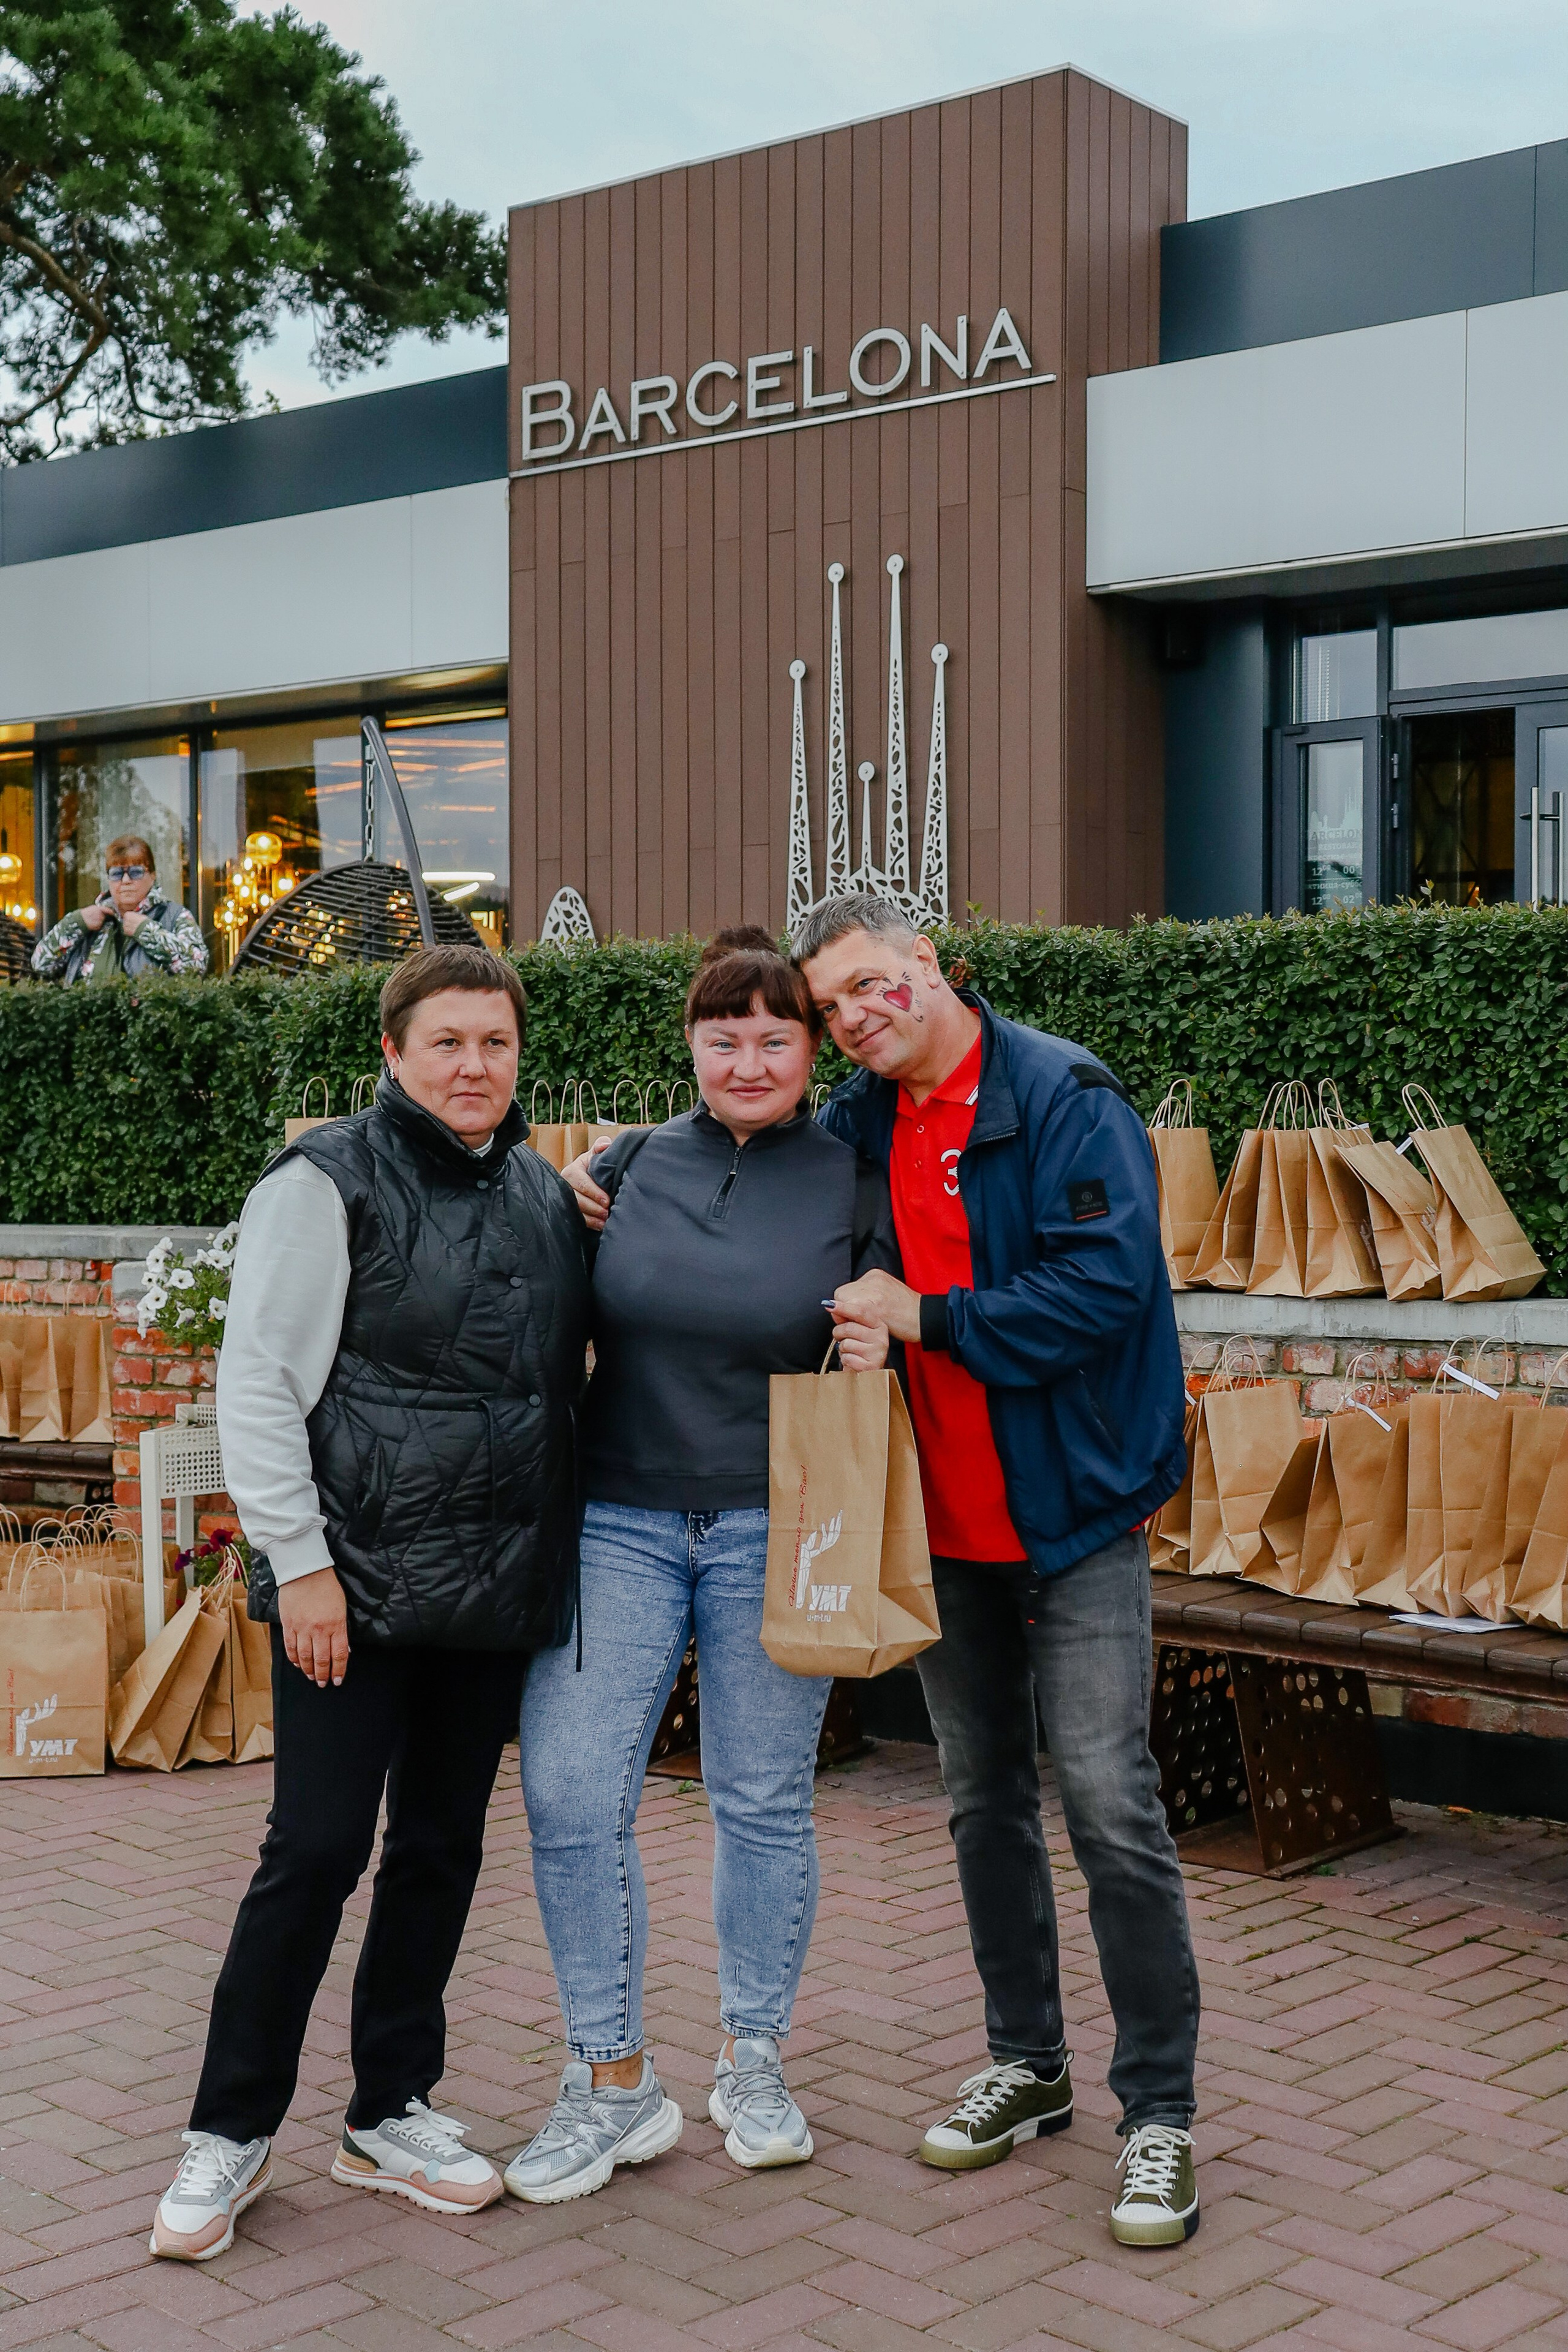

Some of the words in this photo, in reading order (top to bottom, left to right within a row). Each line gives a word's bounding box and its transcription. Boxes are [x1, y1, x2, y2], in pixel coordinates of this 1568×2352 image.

[522, 307, 1033, 461] BARCELONA
[809, 1585, 852, 1612] УМТ
[29, 1738, 78, 1757] УМТ
